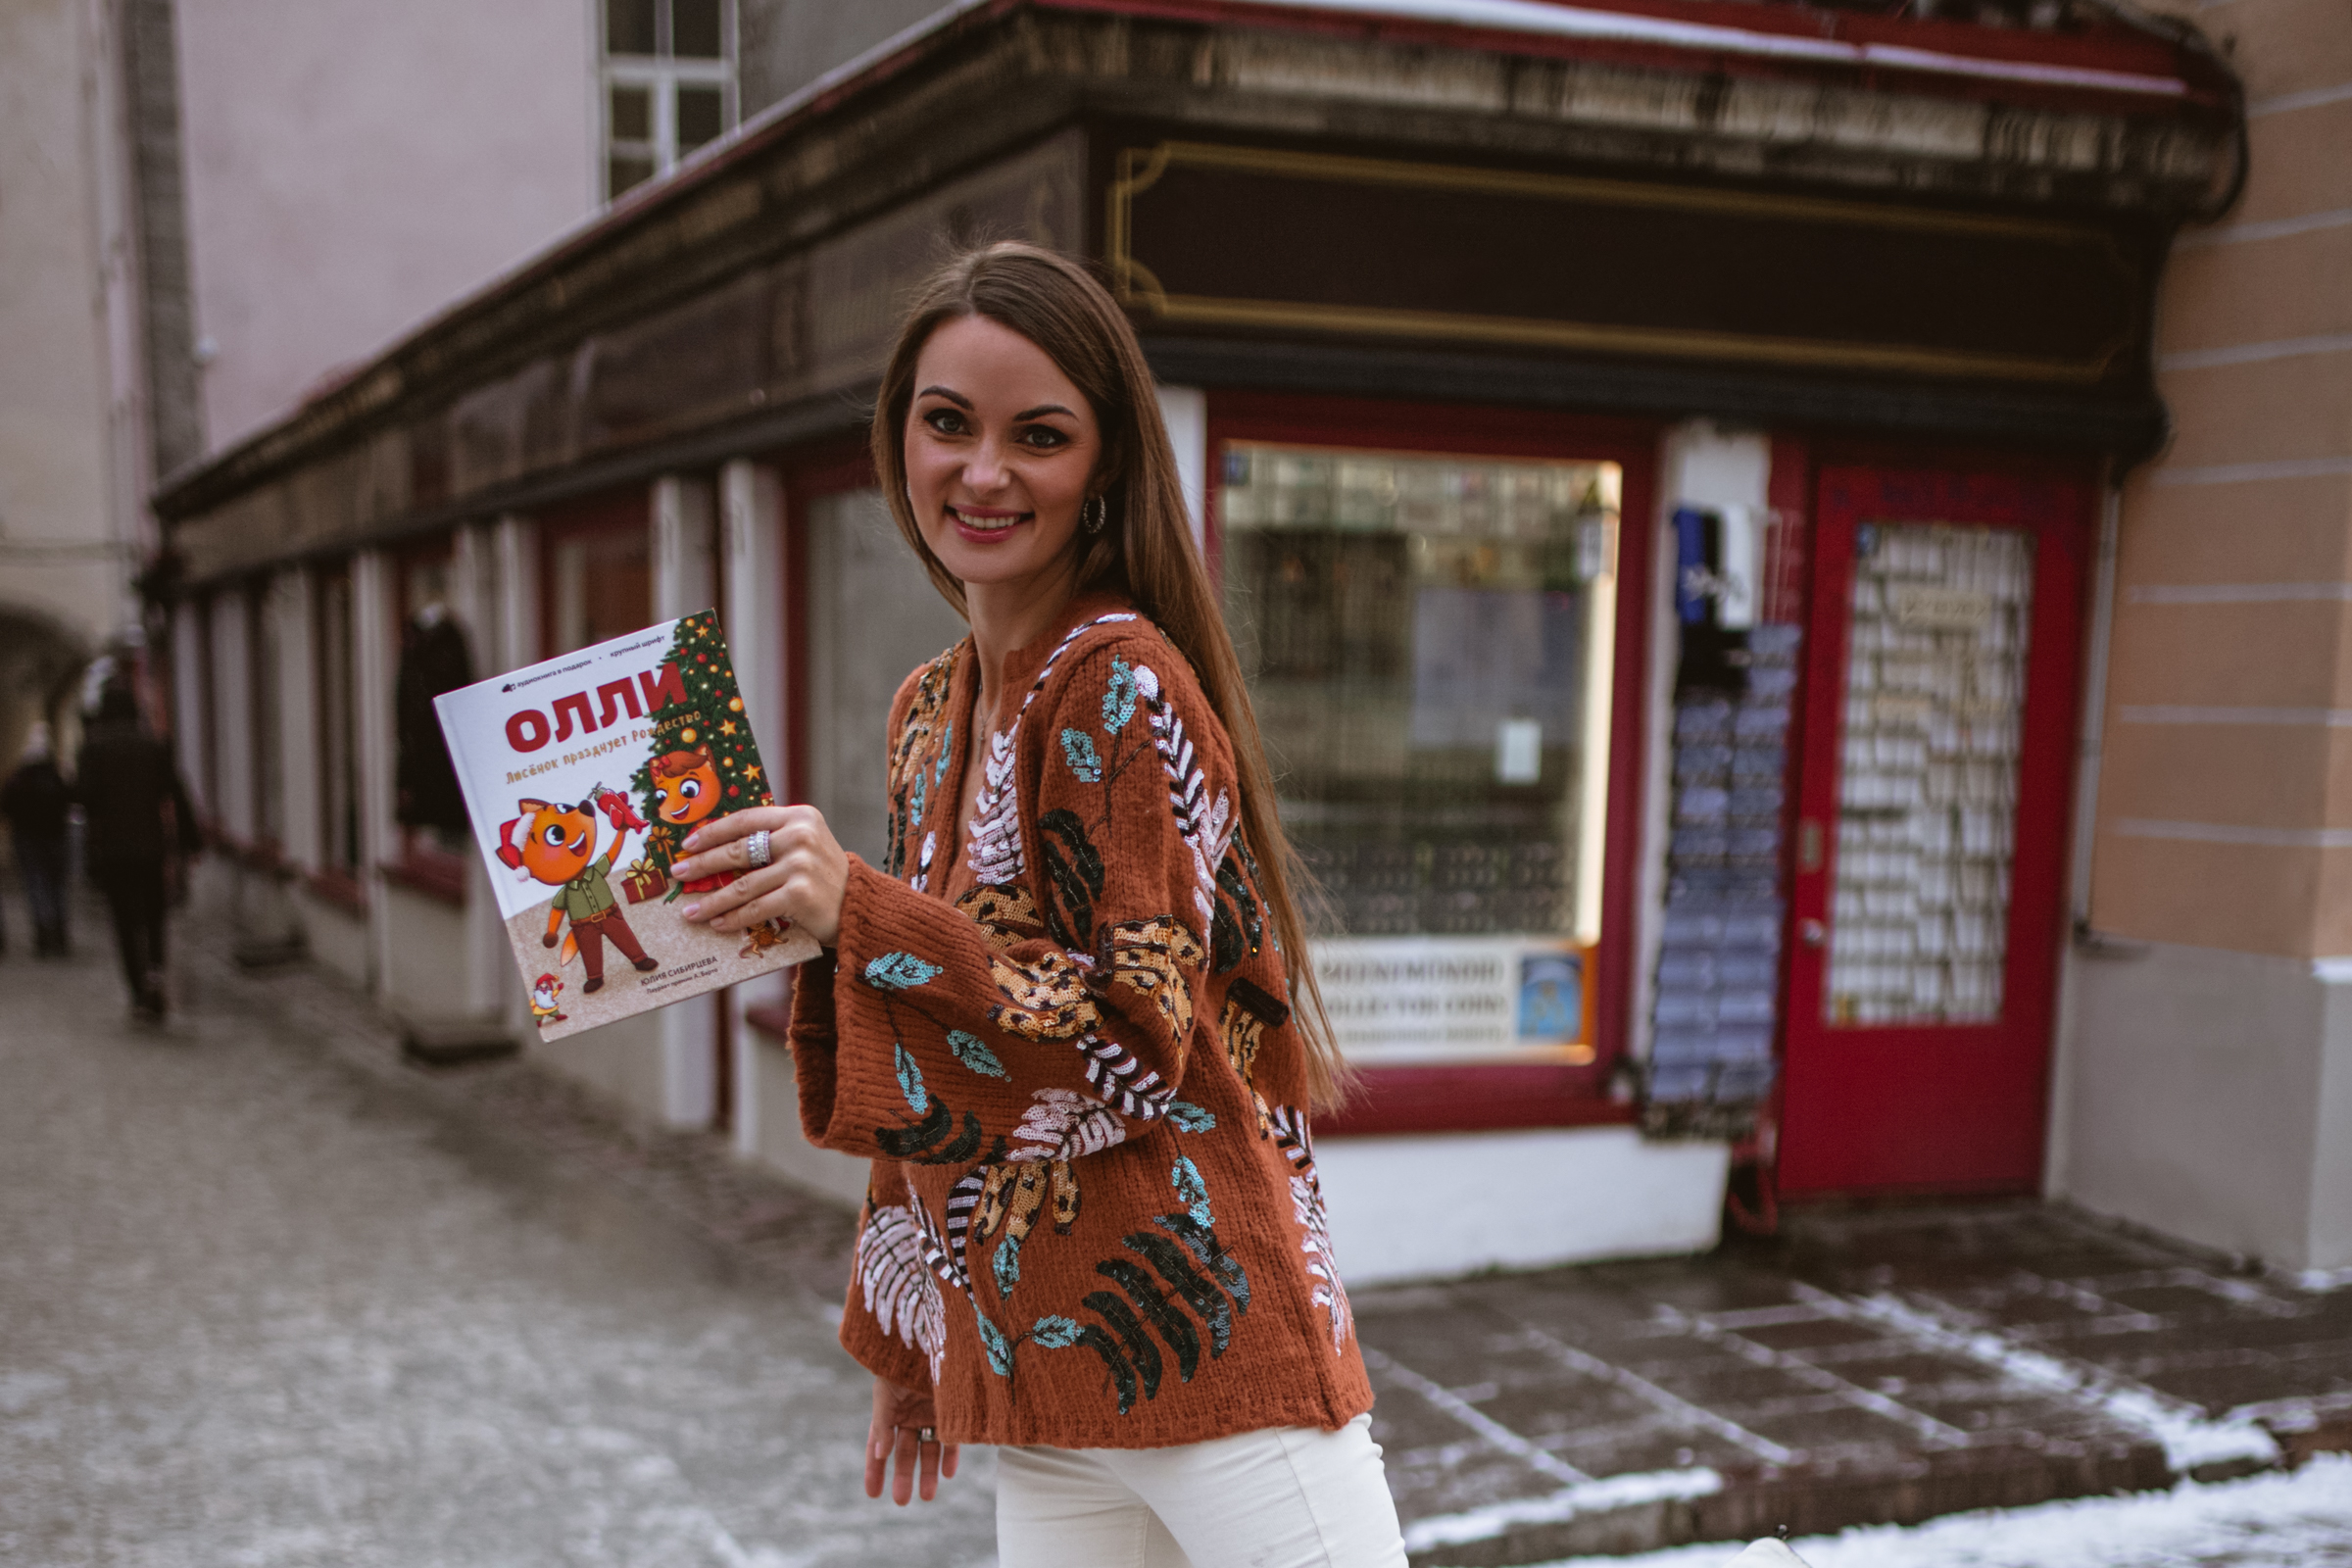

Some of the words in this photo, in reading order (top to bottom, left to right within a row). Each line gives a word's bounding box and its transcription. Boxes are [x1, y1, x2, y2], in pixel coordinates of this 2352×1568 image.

[610, 642, 641, 658] крупный
[642, 635, 665, 648] шрифт
[516, 670, 557, 688] аудиокнига
[563, 659, 592, 673] подарок
[506, 758, 559, 785] Лисёнок
[563, 735, 627, 765] празднует
[631, 710, 702, 743] Рождество
[640, 971, 667, 986] ЮЛИЯ
[667, 956, 718, 977] СИБИРЦЕВА
